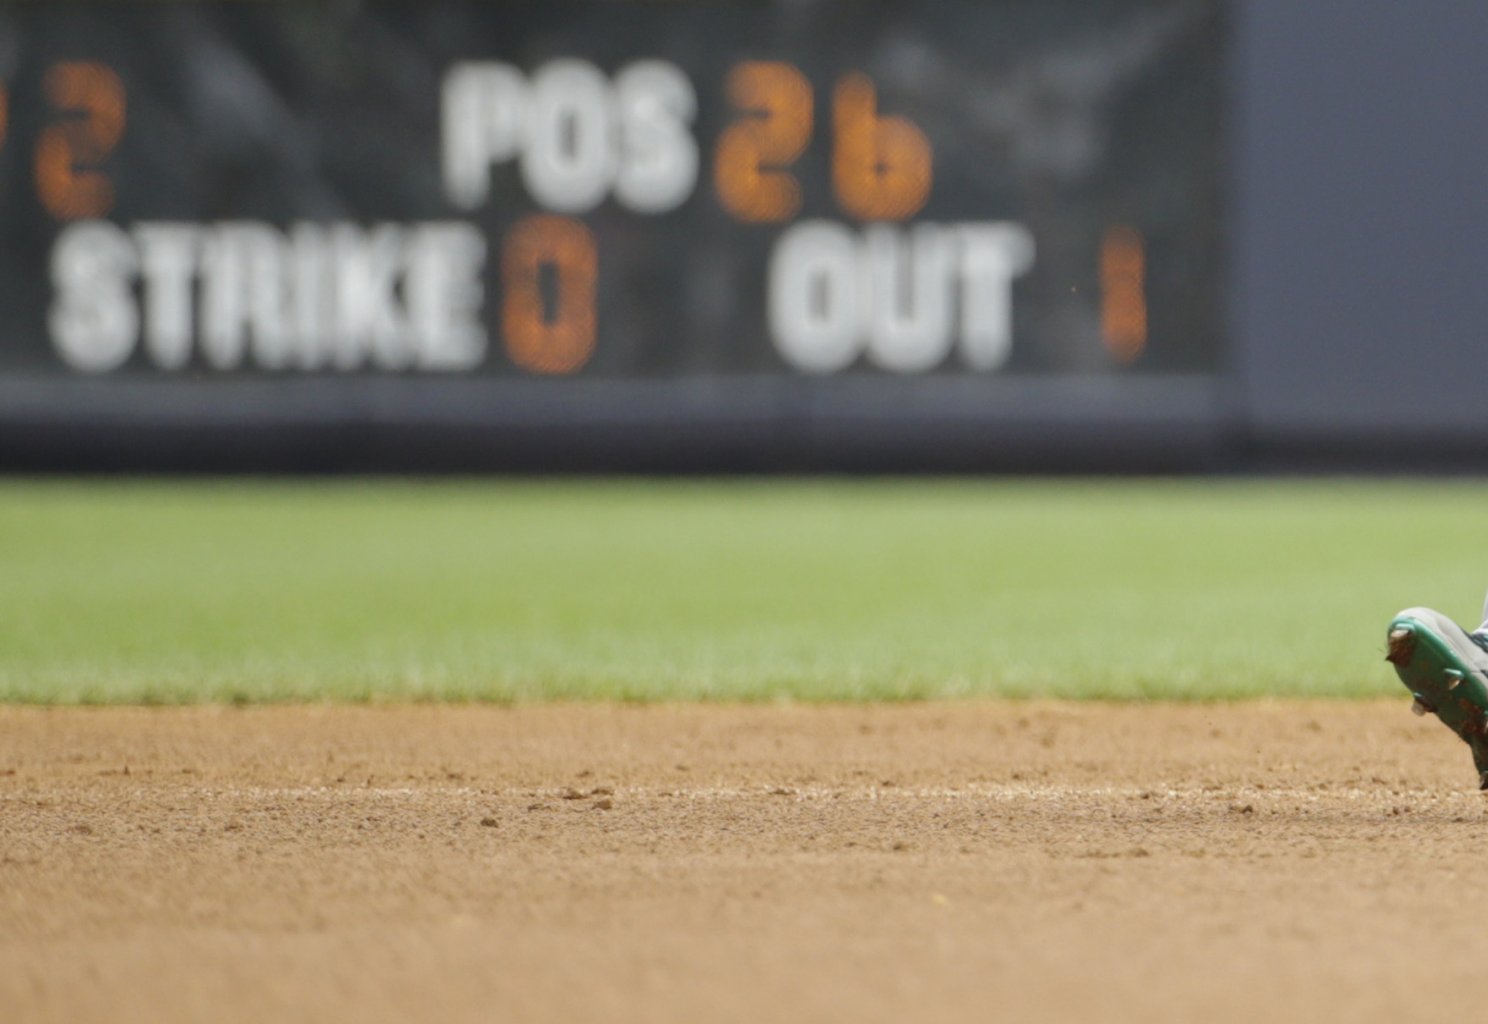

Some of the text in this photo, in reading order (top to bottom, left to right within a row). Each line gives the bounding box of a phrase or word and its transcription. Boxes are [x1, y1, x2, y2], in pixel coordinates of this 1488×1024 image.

[440, 58, 699, 214] POS
[46, 214, 1147, 373] STRIKE 0 OUT 1
